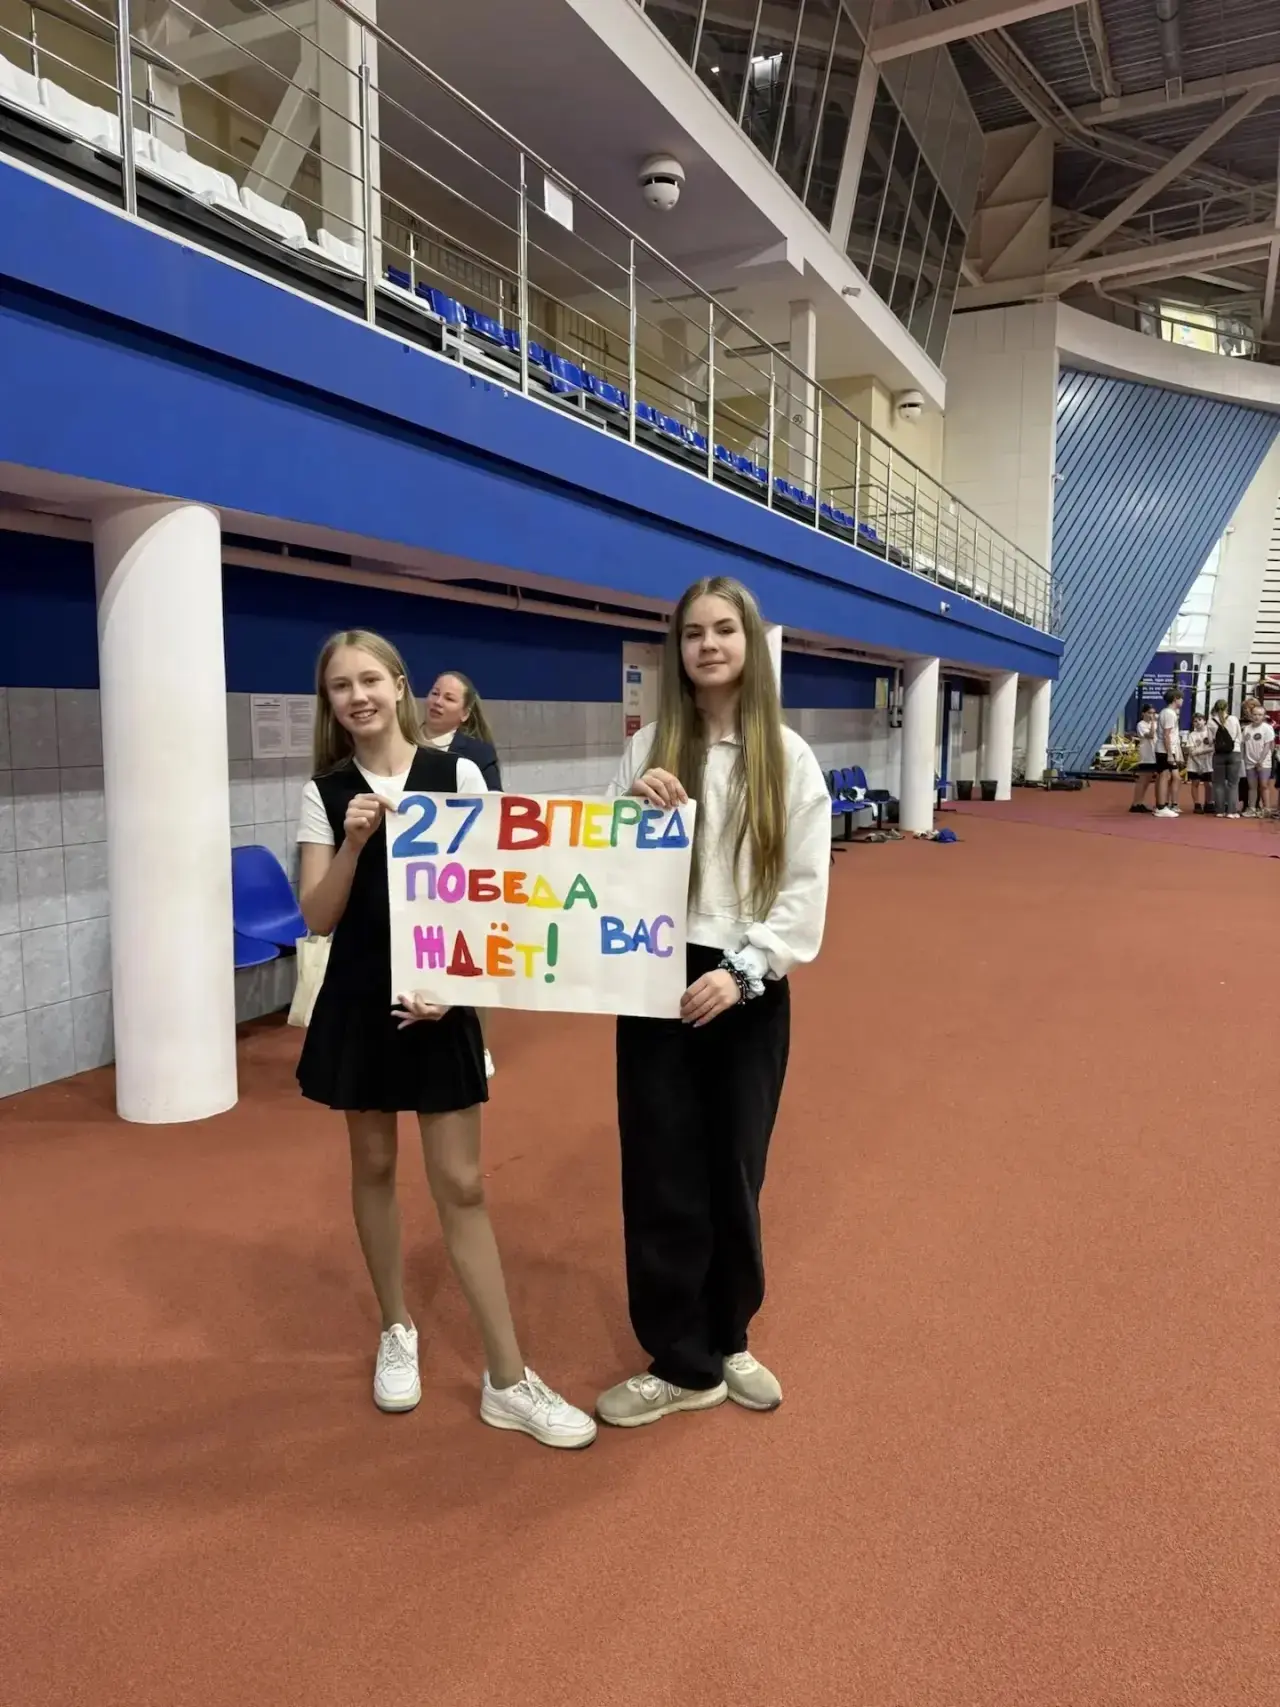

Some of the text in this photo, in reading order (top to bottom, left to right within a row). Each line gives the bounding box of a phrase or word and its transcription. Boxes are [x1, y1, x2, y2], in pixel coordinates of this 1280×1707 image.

[392, 795, 484, 858] 27
[405, 861, 598, 910] ПОБЕДА
[413, 915, 675, 983] ЖДЁТ! ВАС
